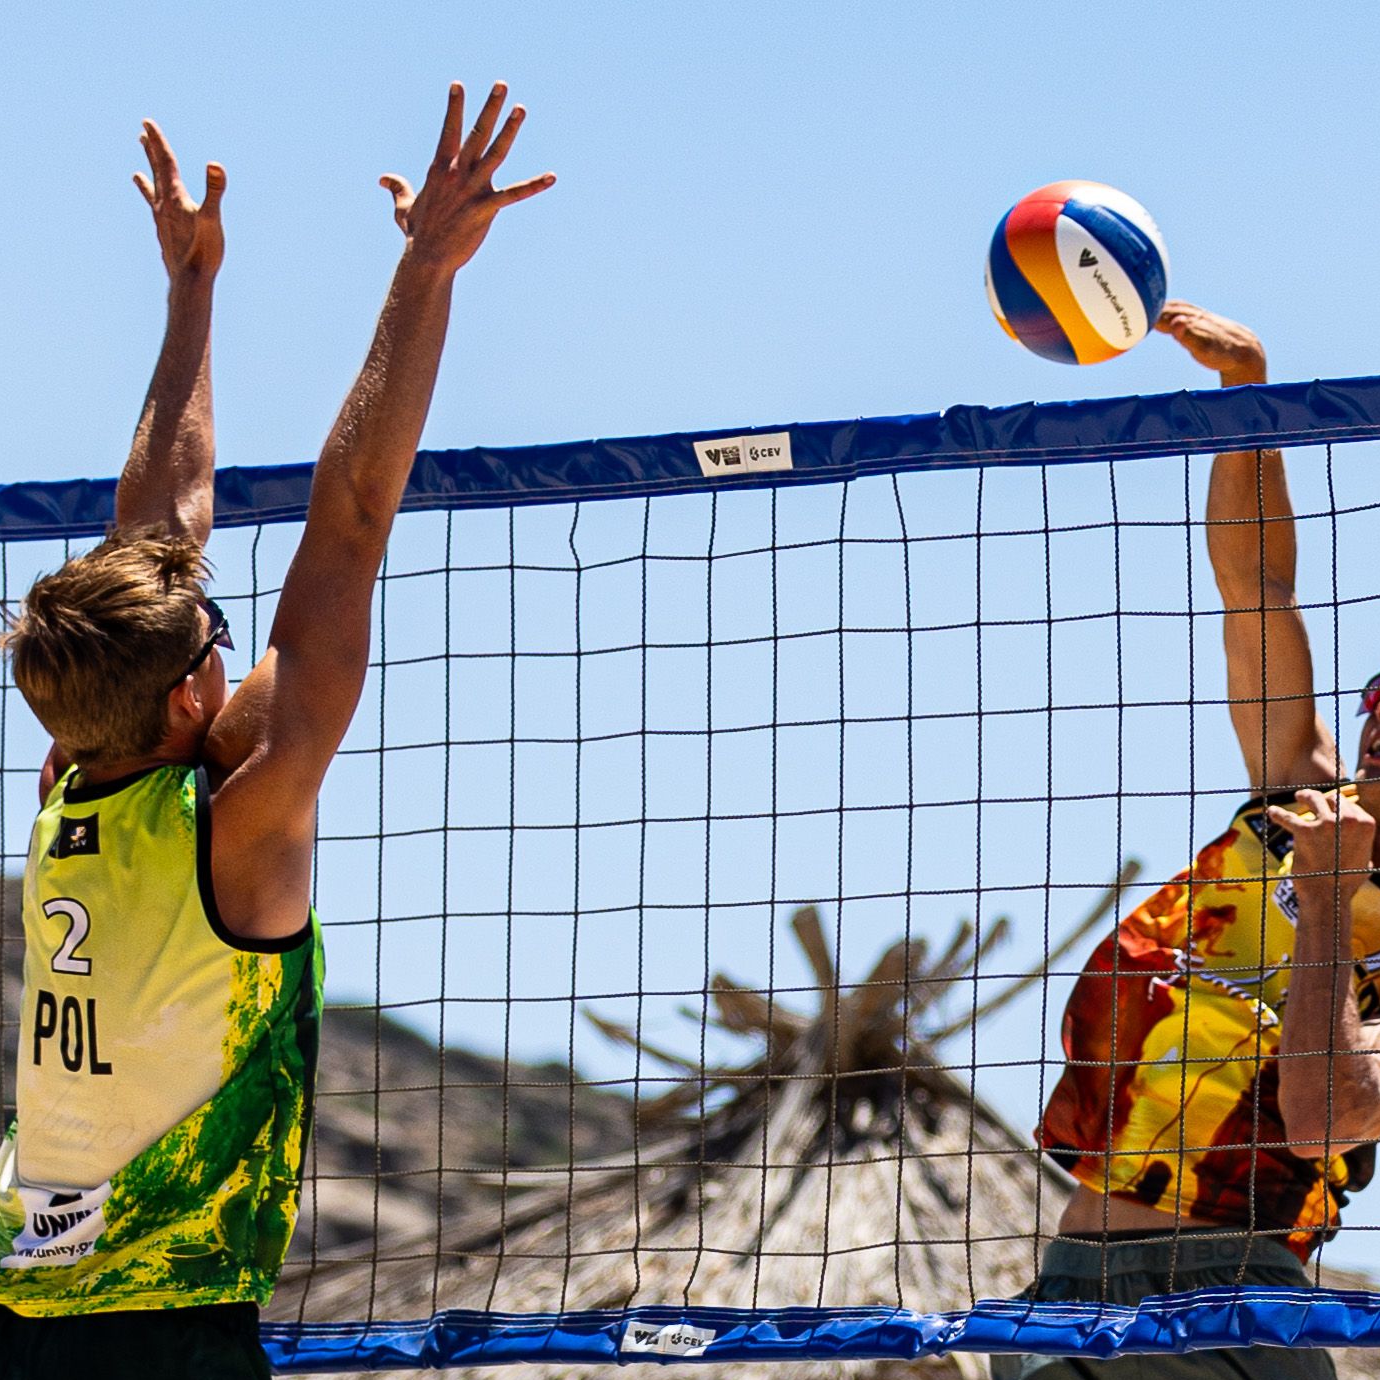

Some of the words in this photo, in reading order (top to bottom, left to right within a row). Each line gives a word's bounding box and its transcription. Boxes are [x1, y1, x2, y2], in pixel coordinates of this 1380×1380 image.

[760, 447, 781, 458] CEV
[42, 896, 92, 976] 2
[33, 989, 113, 1075] POL
